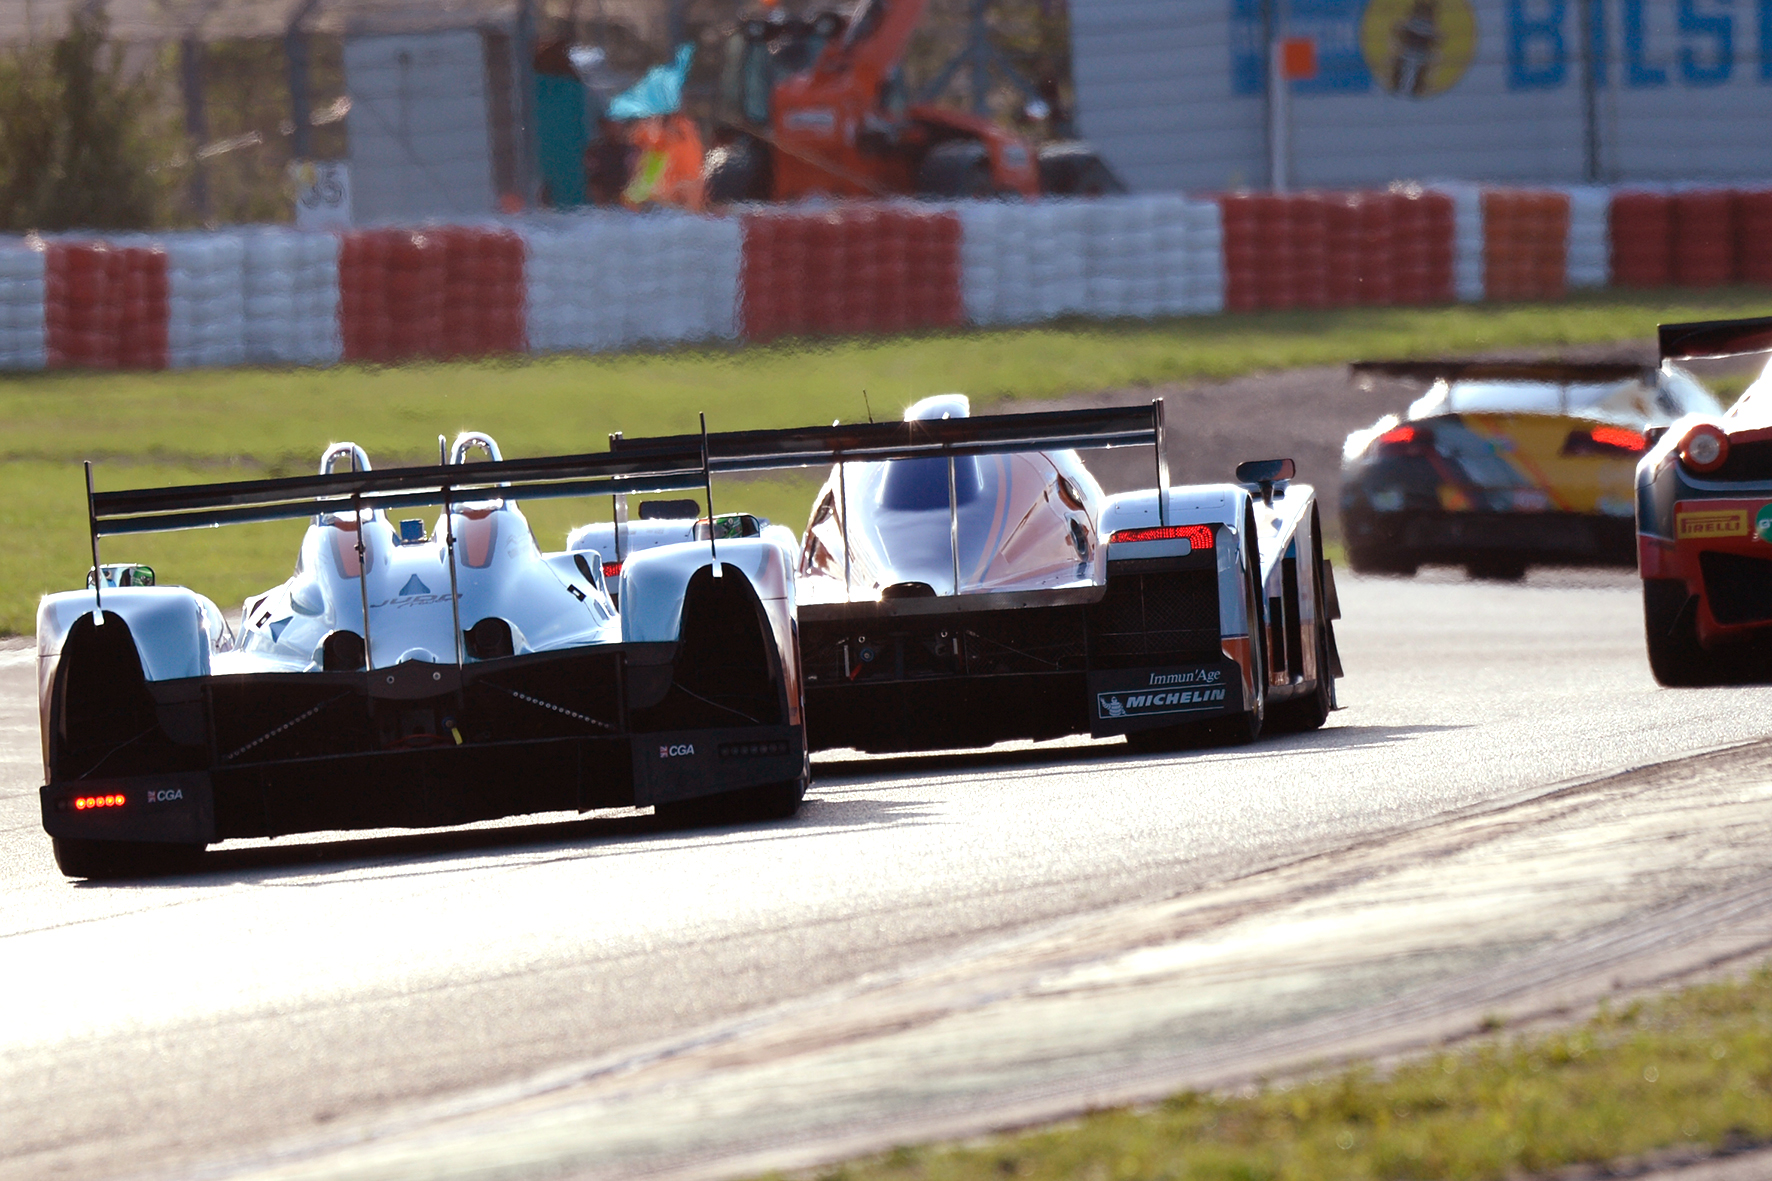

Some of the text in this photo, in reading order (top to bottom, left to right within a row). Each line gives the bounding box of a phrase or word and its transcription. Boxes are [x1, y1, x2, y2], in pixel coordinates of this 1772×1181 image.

[1505, 0, 1772, 90] BILS
[1681, 515, 1741, 534] PIRELLI
[1149, 669, 1221, 685] Immun'Age
[1126, 689, 1226, 708] MICHELIN
[668, 744, 695, 757] CGA
[156, 789, 183, 802] CGA
